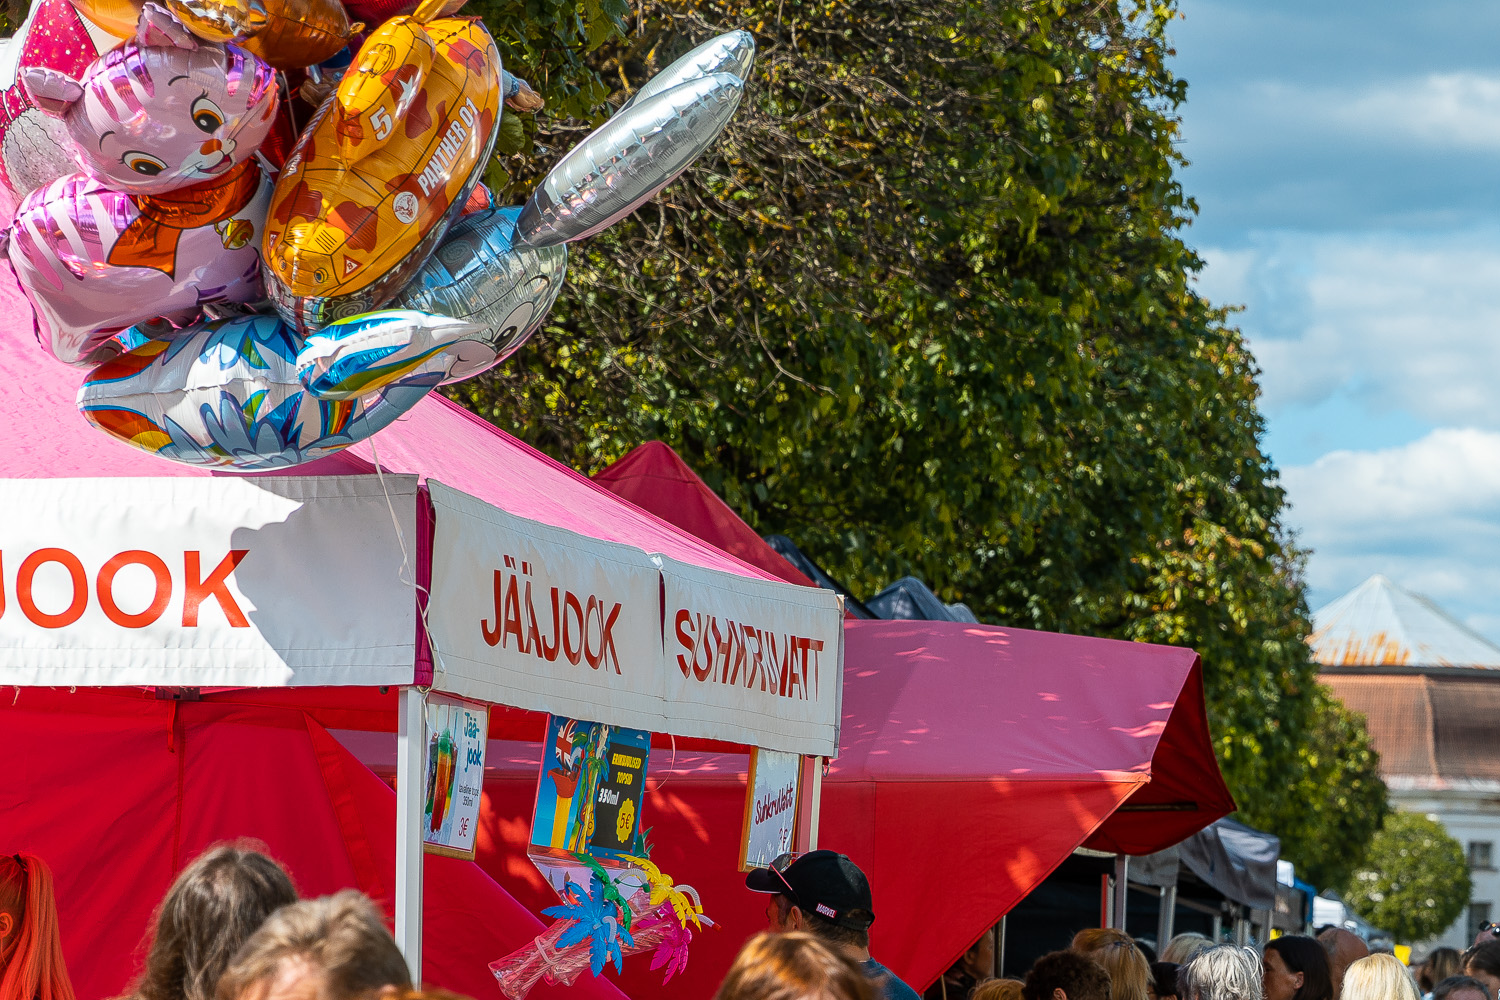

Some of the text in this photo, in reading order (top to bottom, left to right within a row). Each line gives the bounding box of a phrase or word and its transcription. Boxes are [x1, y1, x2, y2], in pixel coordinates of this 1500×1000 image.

[369, 105, 393, 142] 5
[417, 96, 479, 197] PANTHER 01
[0, 547, 250, 629] OOK
[480, 554, 622, 676] JÄÄJOOK
[674, 608, 824, 703] SUHKRUVATT
[598, 787, 620, 806] 350ml
[619, 812, 632, 830] 5€
[816, 903, 837, 918] MARVEL
